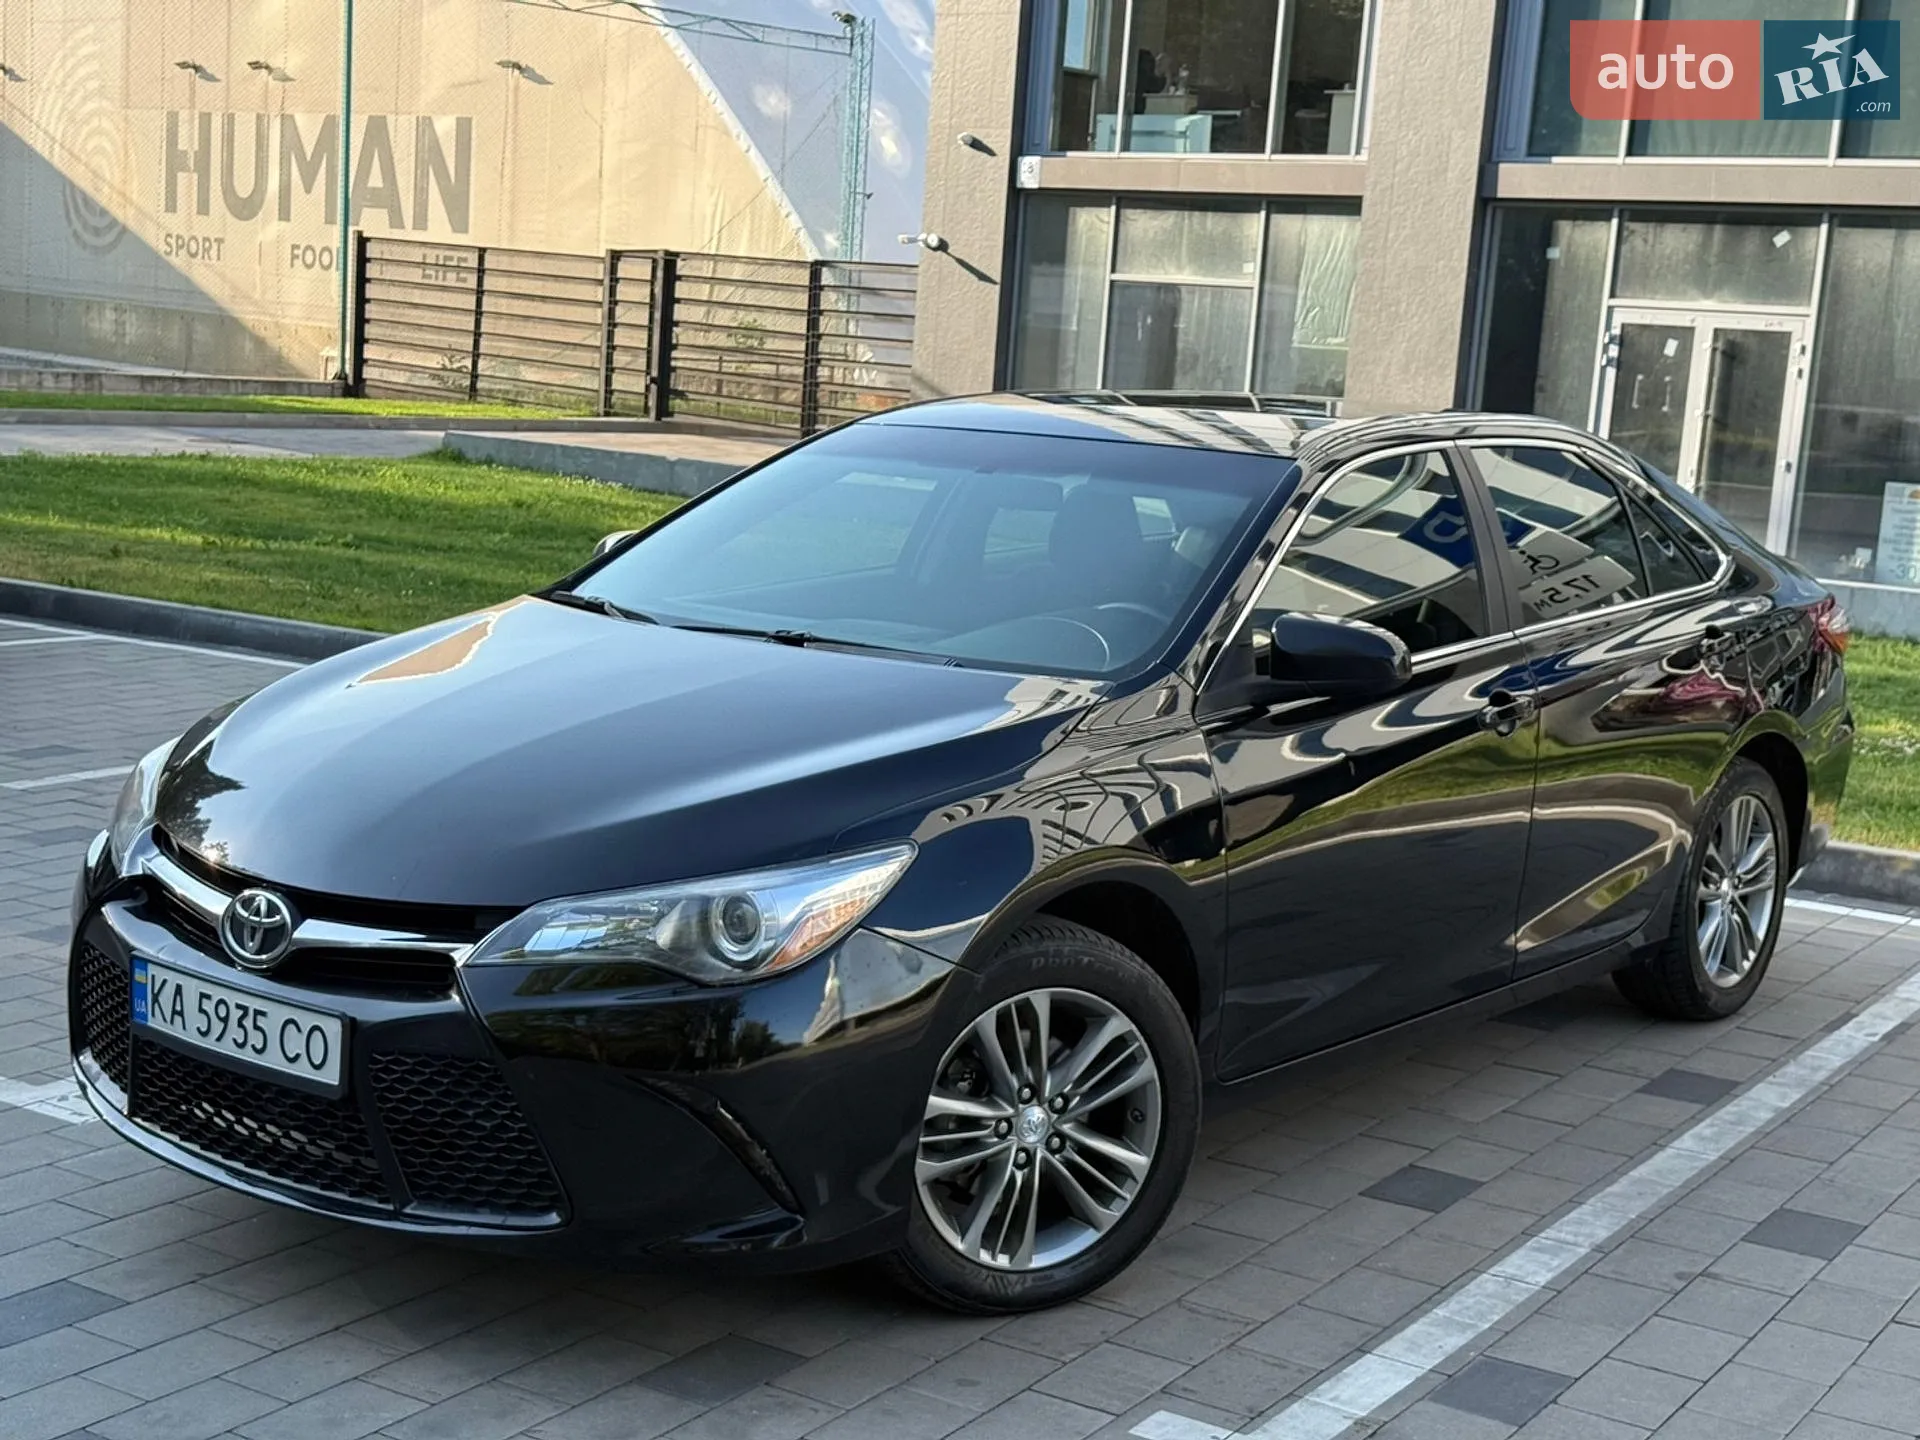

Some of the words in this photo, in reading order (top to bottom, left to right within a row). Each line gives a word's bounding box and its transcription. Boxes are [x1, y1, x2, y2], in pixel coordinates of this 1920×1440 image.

[164, 110, 473, 234] HUMAN
[163, 233, 225, 262] SPORT
[290, 244, 341, 272] FOO
[421, 252, 468, 284] LIFE
[134, 997, 147, 1015] UA
[150, 973, 187, 1032] KA
[196, 990, 269, 1056] 5935
[279, 1017, 329, 1071] CO
